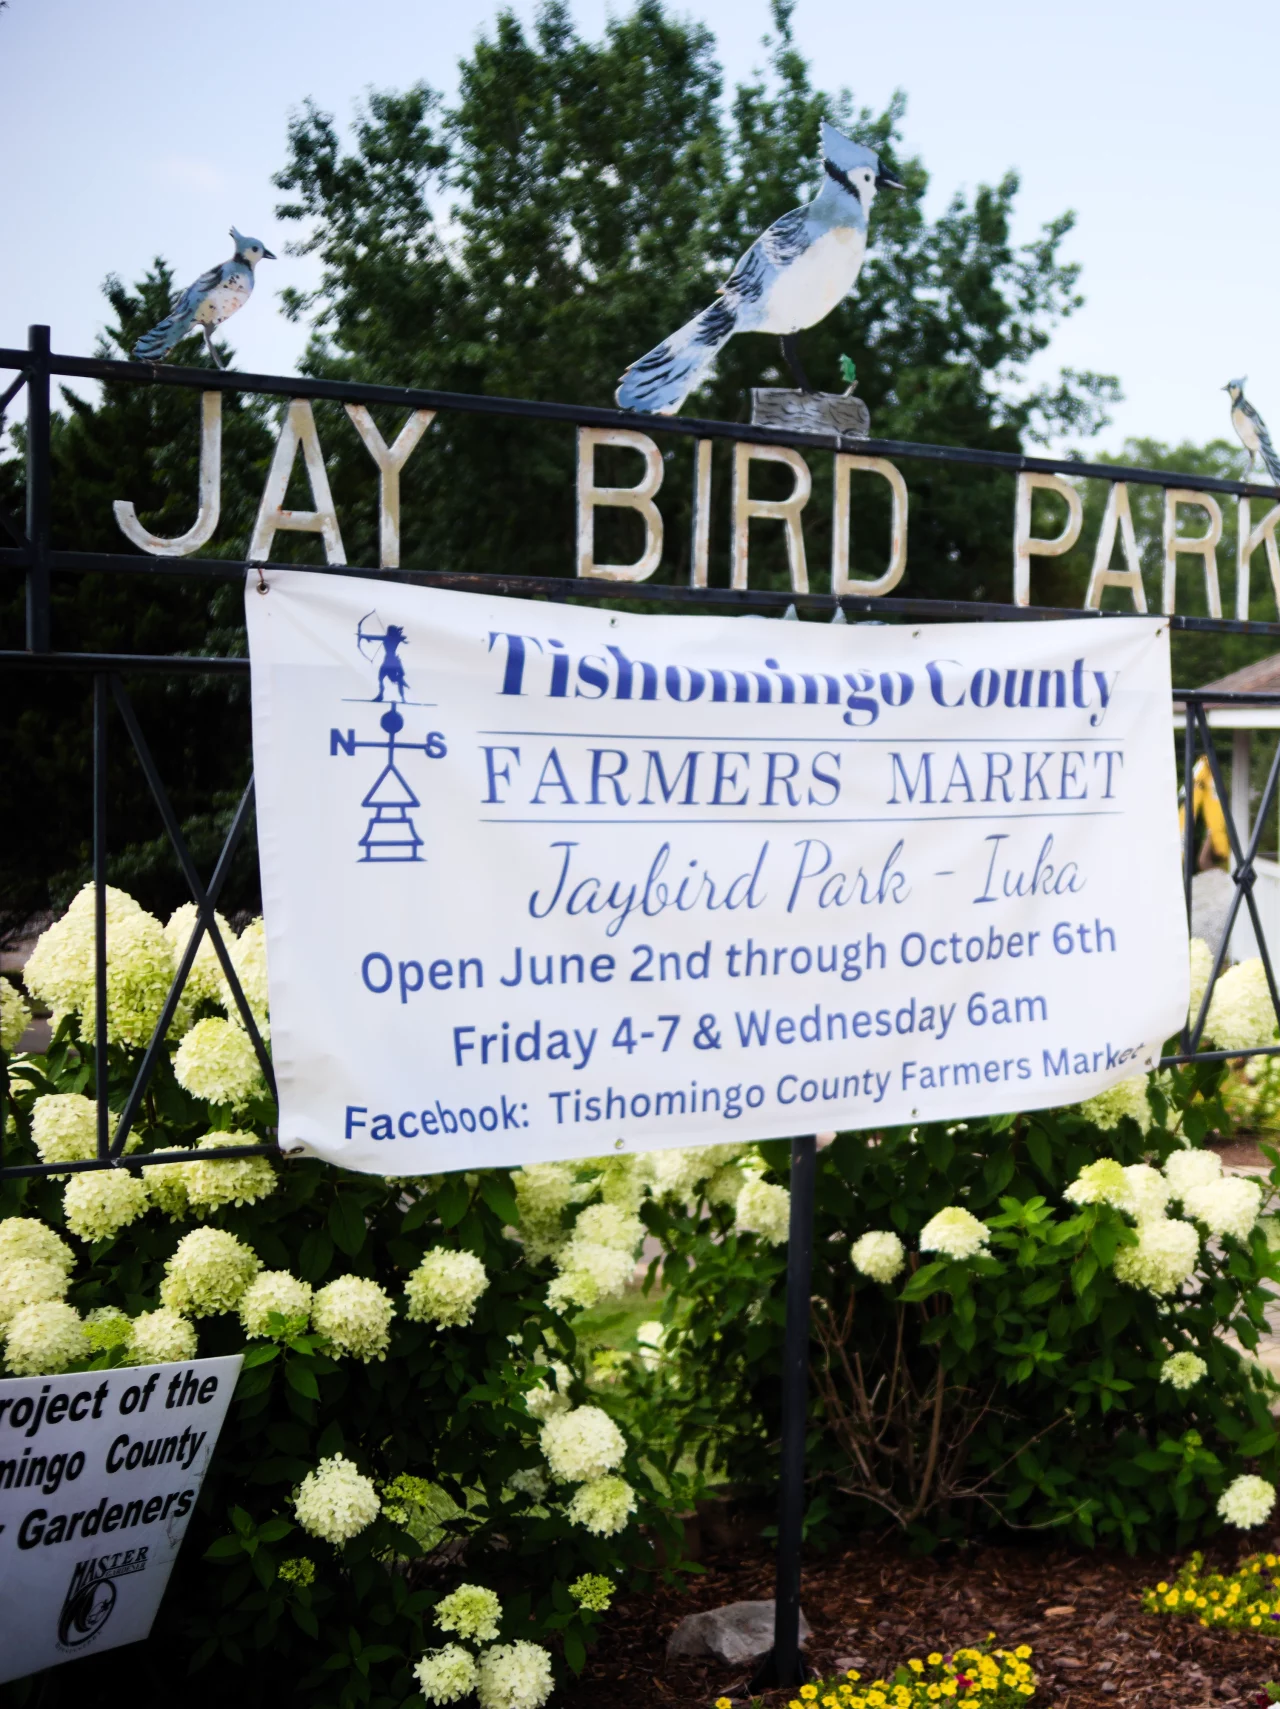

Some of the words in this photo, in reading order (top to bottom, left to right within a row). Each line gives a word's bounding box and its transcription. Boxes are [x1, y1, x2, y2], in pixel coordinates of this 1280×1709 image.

[113, 391, 437, 569] JAY
[576, 427, 909, 598] BIRD
[488, 631, 914, 727] Tishomingo
[925, 657, 1121, 727] County
[330, 728, 356, 756] N
[424, 731, 447, 759] S
[479, 746, 842, 807] FARMERS
[886, 750, 1125, 805] MARKET
[528, 840, 769, 938] Jaybird
[786, 838, 912, 914] Park
[972, 833, 1087, 904] Iuka
[361, 952, 484, 1004] Open
[500, 946, 616, 987] June
[630, 940, 711, 983] 2nd
[726, 932, 886, 982] through
[900, 925, 1041, 968] October
[1052, 918, 1117, 955] 6th
[452, 1019, 598, 1070] Friday
[611, 1014, 681, 1055] 4-7
[692, 1013, 722, 1051] &
[735, 997, 956, 1049] Wednesday
[966, 991, 1048, 1027] 6am
[344, 1093, 530, 1141] Facebook:
[549, 1079, 765, 1126] Tishomingo
[776, 1065, 891, 1103] County
[901, 1055, 1032, 1092] Farmers
[118, 1372, 161, 1416] of
[164, 1368, 219, 1410] the
[105, 1424, 208, 1475] County
[17, 1487, 196, 1551] Gardeners
[67, 1546, 149, 1592] MASTER
